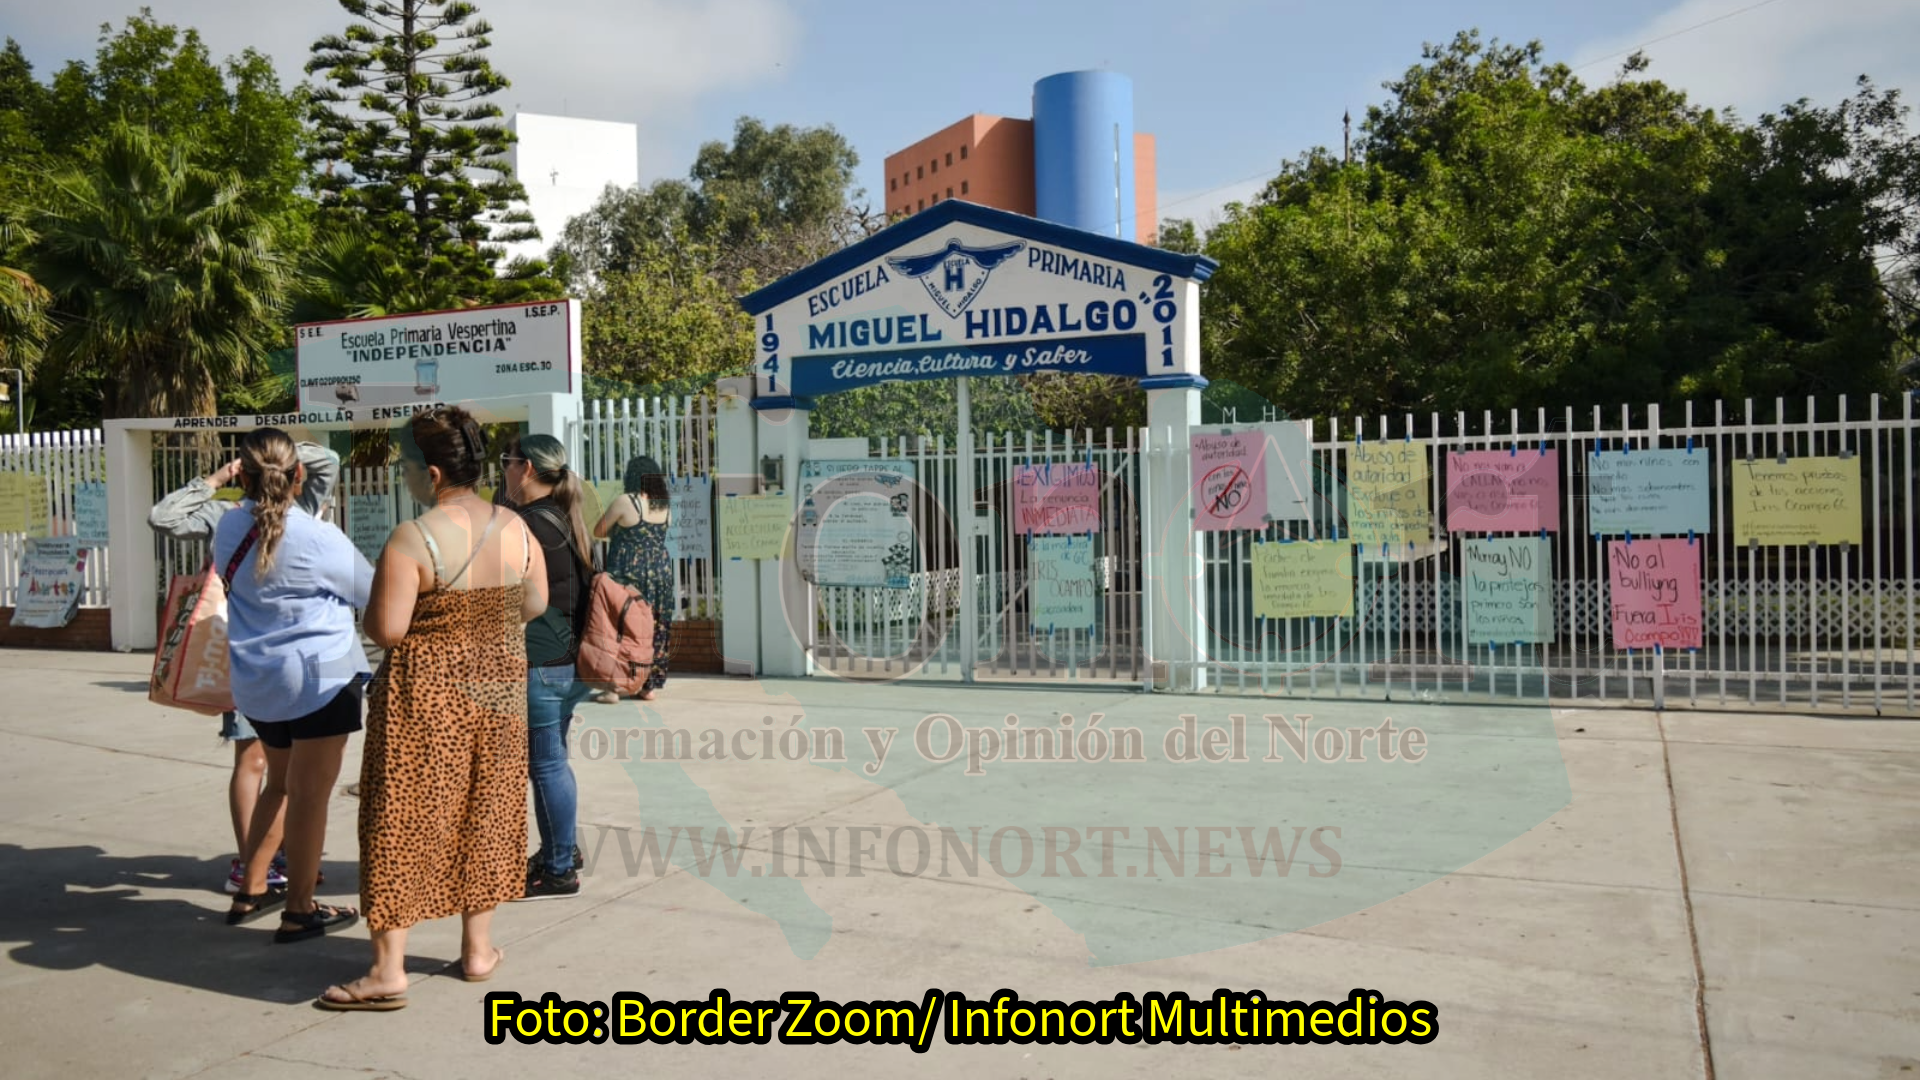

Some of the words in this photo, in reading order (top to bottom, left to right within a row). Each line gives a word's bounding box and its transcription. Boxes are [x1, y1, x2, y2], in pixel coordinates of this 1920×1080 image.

[808, 265, 890, 317] ESCUELA
[1028, 247, 1126, 292] PRIMARIA
[945, 267, 964, 291] H
[928, 281, 951, 310] MIGUEL
[957, 277, 982, 309] HIDALGO
[341, 328, 385, 350] Escuela
[390, 325, 442, 345] Primaria
[448, 319, 517, 343] Vespertina
[809, 314, 941, 350] MIGUEL
[1002, 353, 1017, 370] y
[1021, 345, 1092, 368] Saber
[495, 364, 518, 374] ZONA
[174, 416, 239, 429] APRENDER
[255, 411, 354, 426] DESARROLLAR
[1355, 444, 1393, 465] Abuso
[1398, 442, 1418, 462] de
[1353, 464, 1411, 483] autoridad
[1740, 463, 1797, 481] Tenemos
[1216, 490, 1241, 512] NO
[1022, 506, 1096, 527] INMEDIATA
[1508, 545, 1532, 571] NO
[1614, 545, 1640, 569] No
[1646, 543, 1665, 569] al
[1031, 560, 1058, 581] IRIS
[1472, 570, 1486, 592] la
[1050, 578, 1093, 599] OCAMPO
[1656, 604, 1697, 626] Iris
